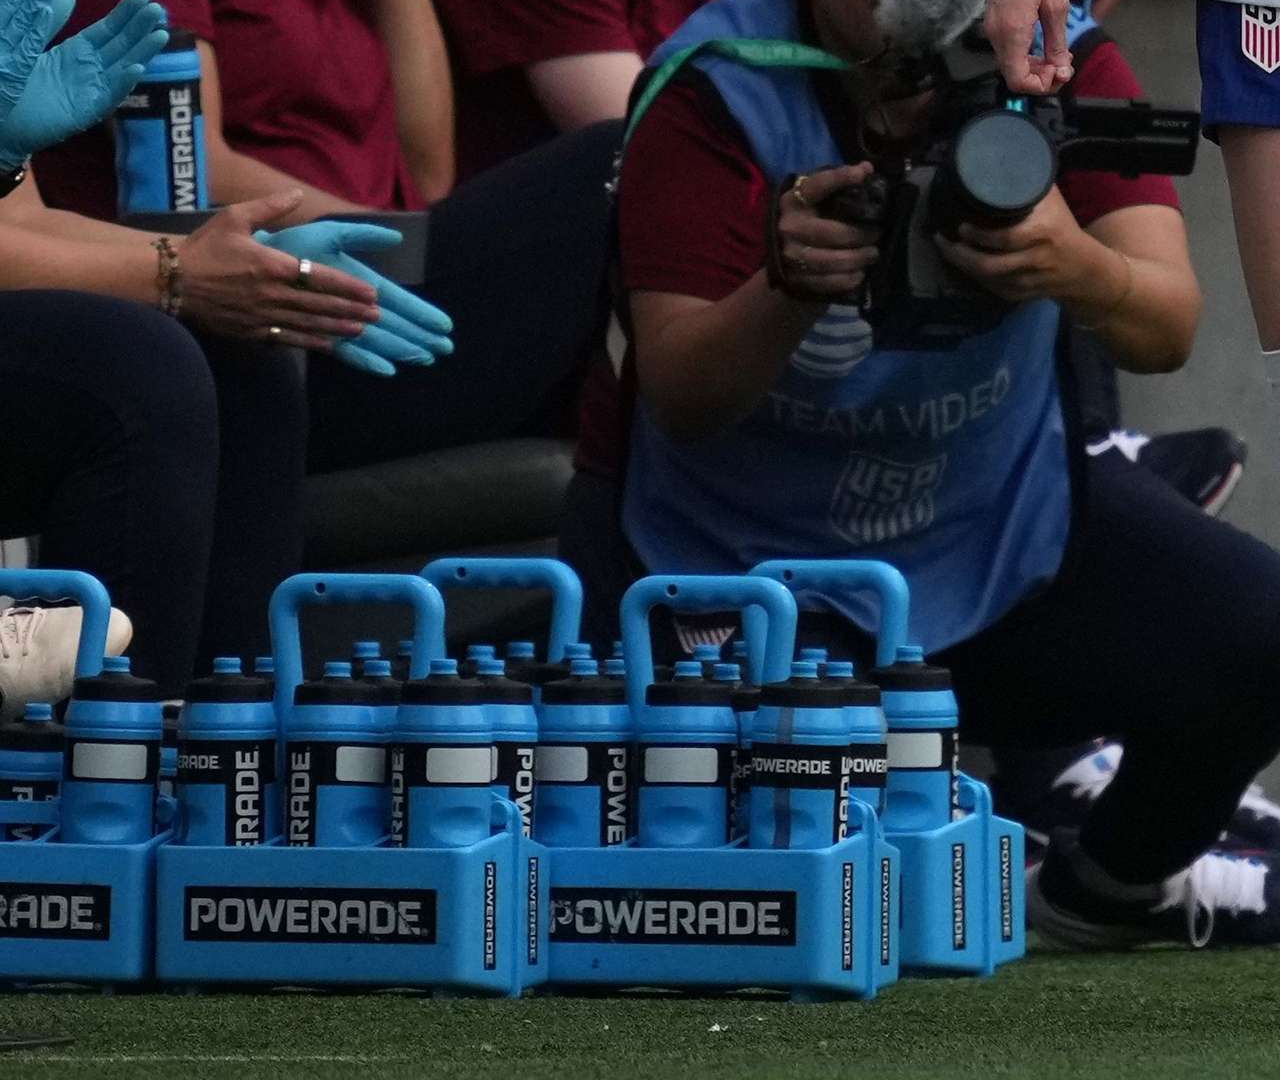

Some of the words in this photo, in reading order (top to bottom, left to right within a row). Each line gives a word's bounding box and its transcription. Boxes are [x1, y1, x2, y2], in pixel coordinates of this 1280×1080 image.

[768, 391, 884, 434] TEAM
[900, 367, 1010, 439] VIDEO
[849, 457, 939, 502] USA
[392, 749, 404, 847] RADE
[607, 748, 626, 847] POWE
[0, 894, 95, 930] ADE
[190, 897, 422, 936] POWERADE
[486, 864, 494, 967] POWERADE
[529, 859, 537, 962] POWERADE
[550, 899, 781, 936] POWERADE
